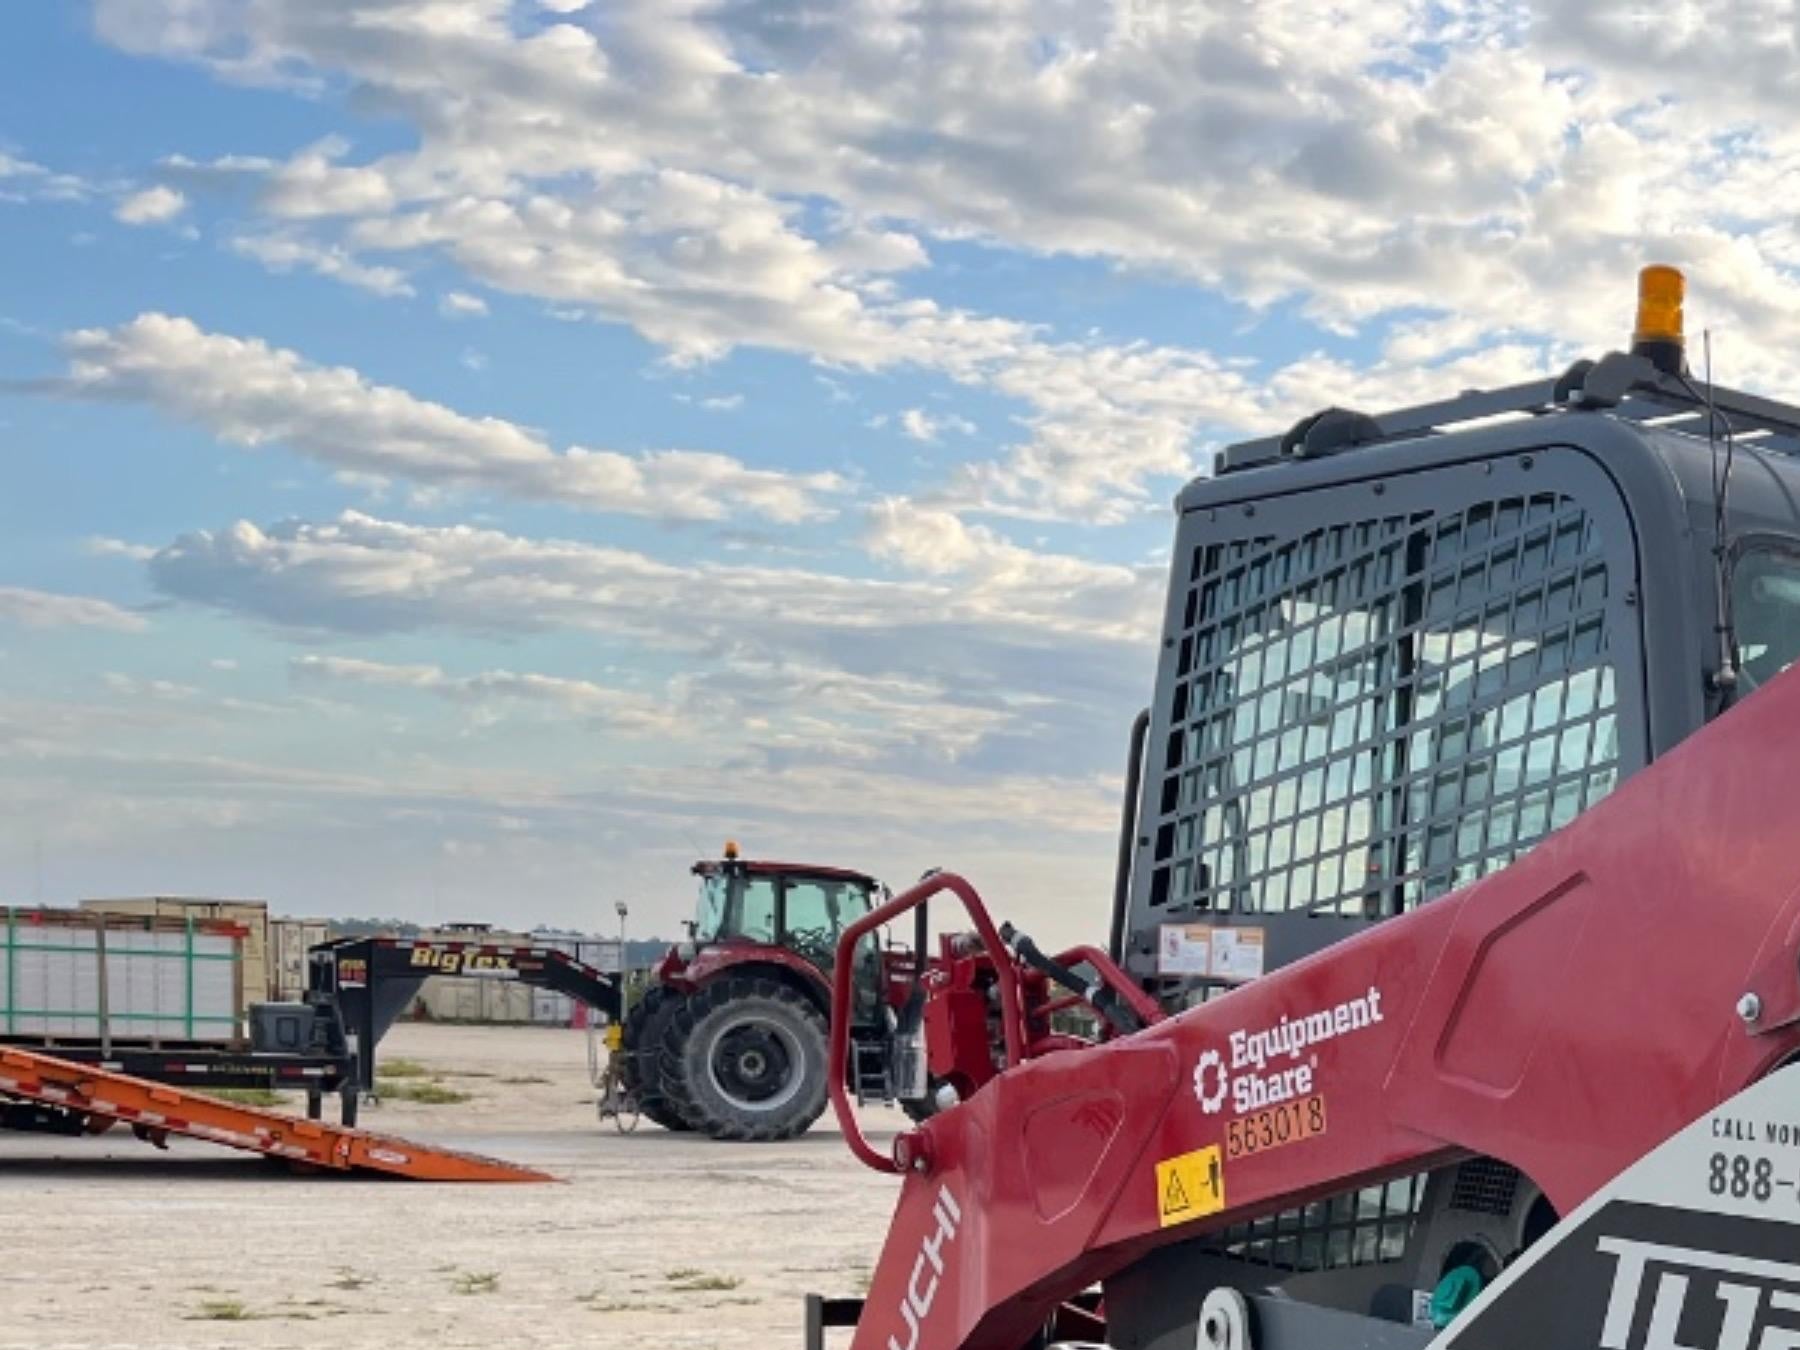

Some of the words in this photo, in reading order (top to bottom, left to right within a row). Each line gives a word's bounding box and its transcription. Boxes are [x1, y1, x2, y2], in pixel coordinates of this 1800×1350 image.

[1229, 986, 1384, 1070] Equipment
[1228, 1097, 1324, 1156] 563018
[1712, 1117, 1756, 1141] CALL
